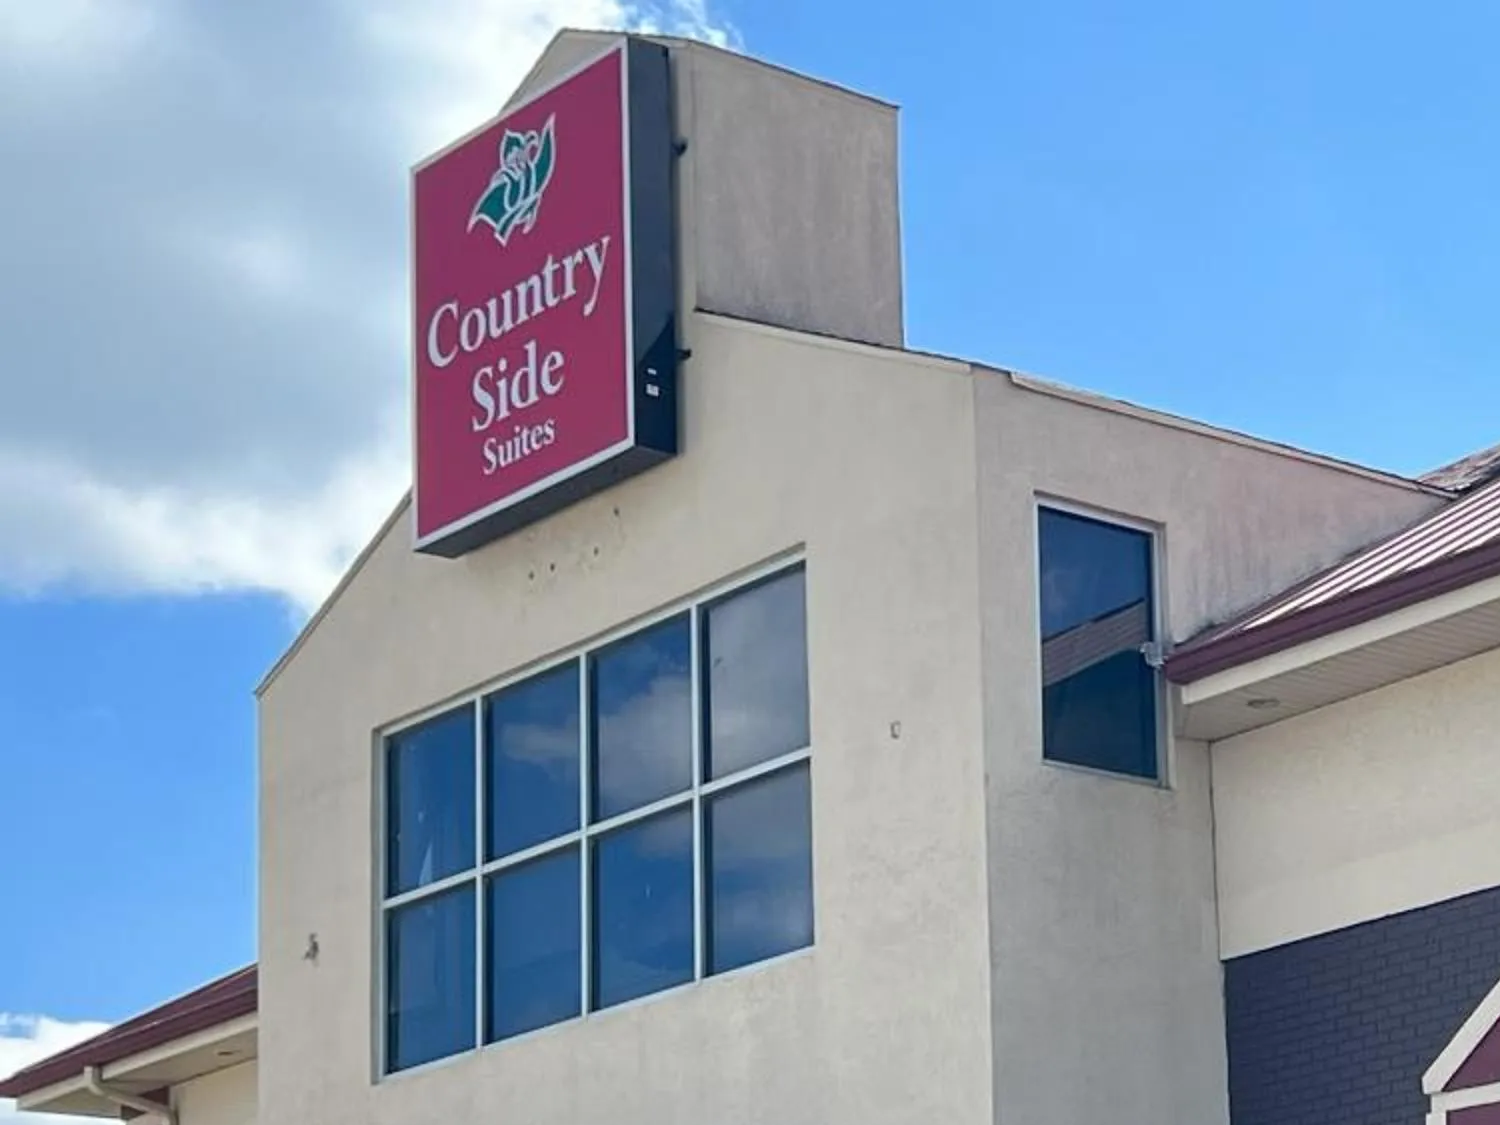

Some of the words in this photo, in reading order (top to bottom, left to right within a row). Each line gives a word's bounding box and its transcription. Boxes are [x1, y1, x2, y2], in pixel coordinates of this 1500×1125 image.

[428, 236, 611, 368] Country
[471, 340, 565, 432] Side
[482, 417, 555, 475] Suites
